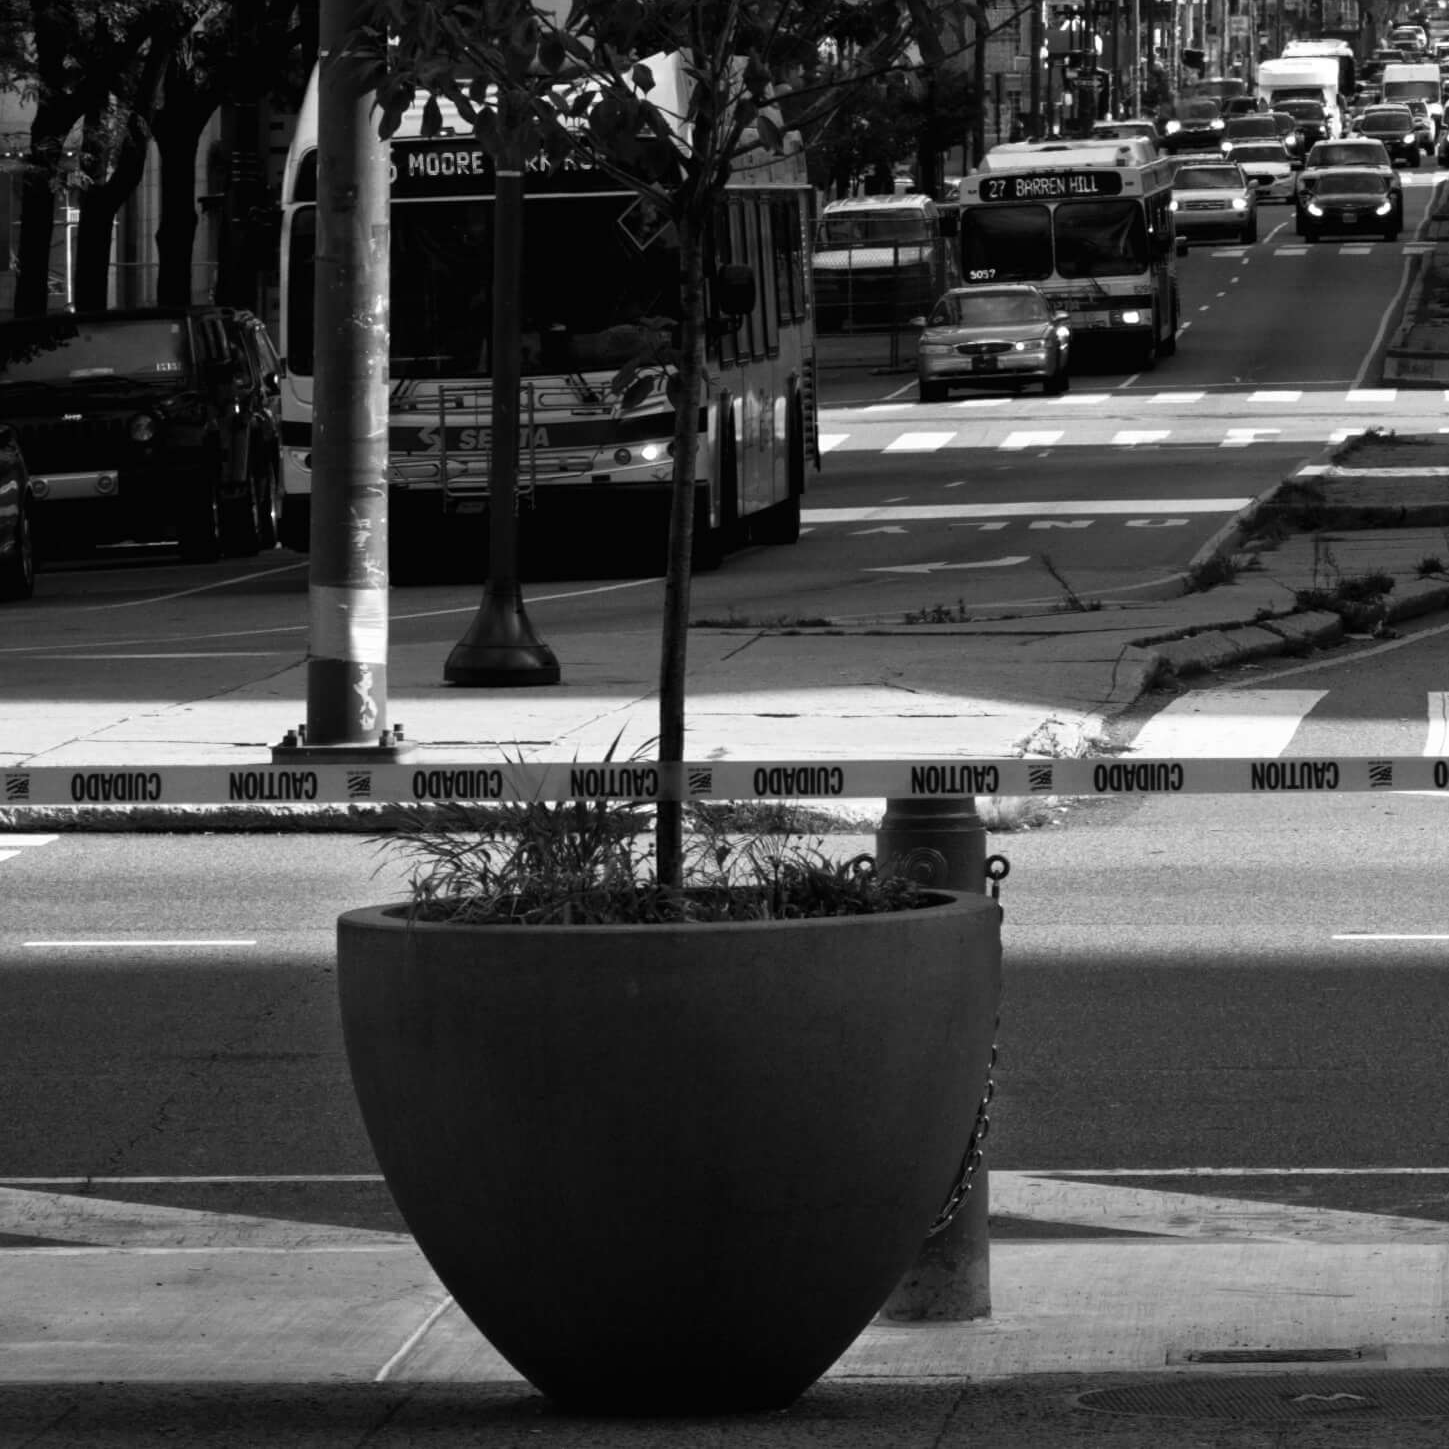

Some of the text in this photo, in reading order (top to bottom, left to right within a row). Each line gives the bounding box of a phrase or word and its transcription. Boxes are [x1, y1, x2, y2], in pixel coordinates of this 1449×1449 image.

[407, 150, 485, 177] MOORE
[988, 175, 1099, 198] 27 BARREN HILL
[458, 426, 550, 450] SETA
[72, 772, 161, 801] CUIDADO
[230, 771, 317, 800] CAUTION
[413, 770, 502, 799] CUIDADO
[571, 769, 658, 797] CAUTION
[754, 767, 843, 796] CUIDADO
[912, 766, 998, 794] CAUTION
[1094, 764, 1183, 792] CUIDADO
[1252, 762, 1339, 790] CAUTION
